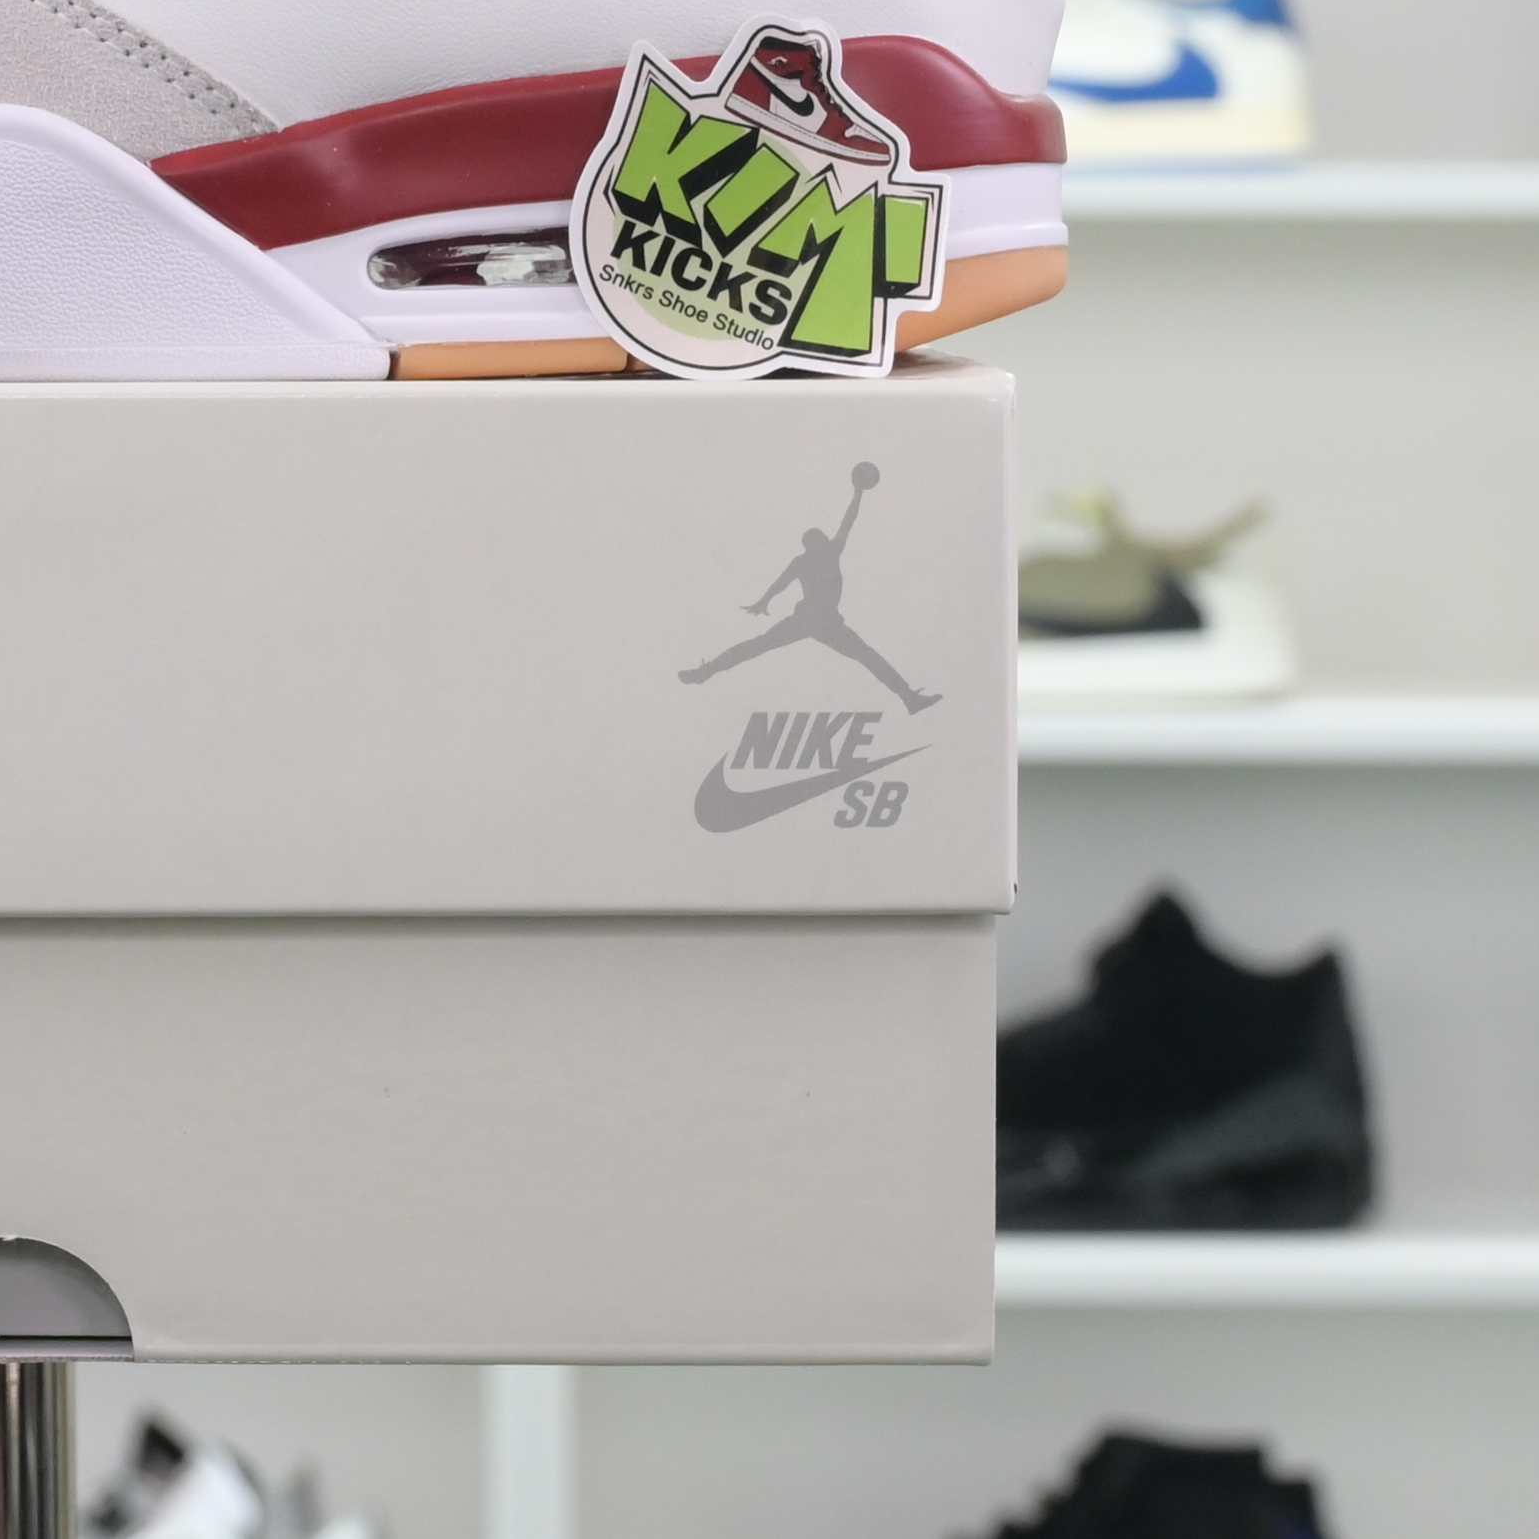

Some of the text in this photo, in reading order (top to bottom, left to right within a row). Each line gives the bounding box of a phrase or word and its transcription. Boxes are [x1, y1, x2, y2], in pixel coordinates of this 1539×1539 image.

[599, 264, 775, 351] Snkrs Shoe Studio
[610, 219, 793, 326] KICKS
[729, 711, 884, 770] NIKE
[832, 780, 910, 829] SB
